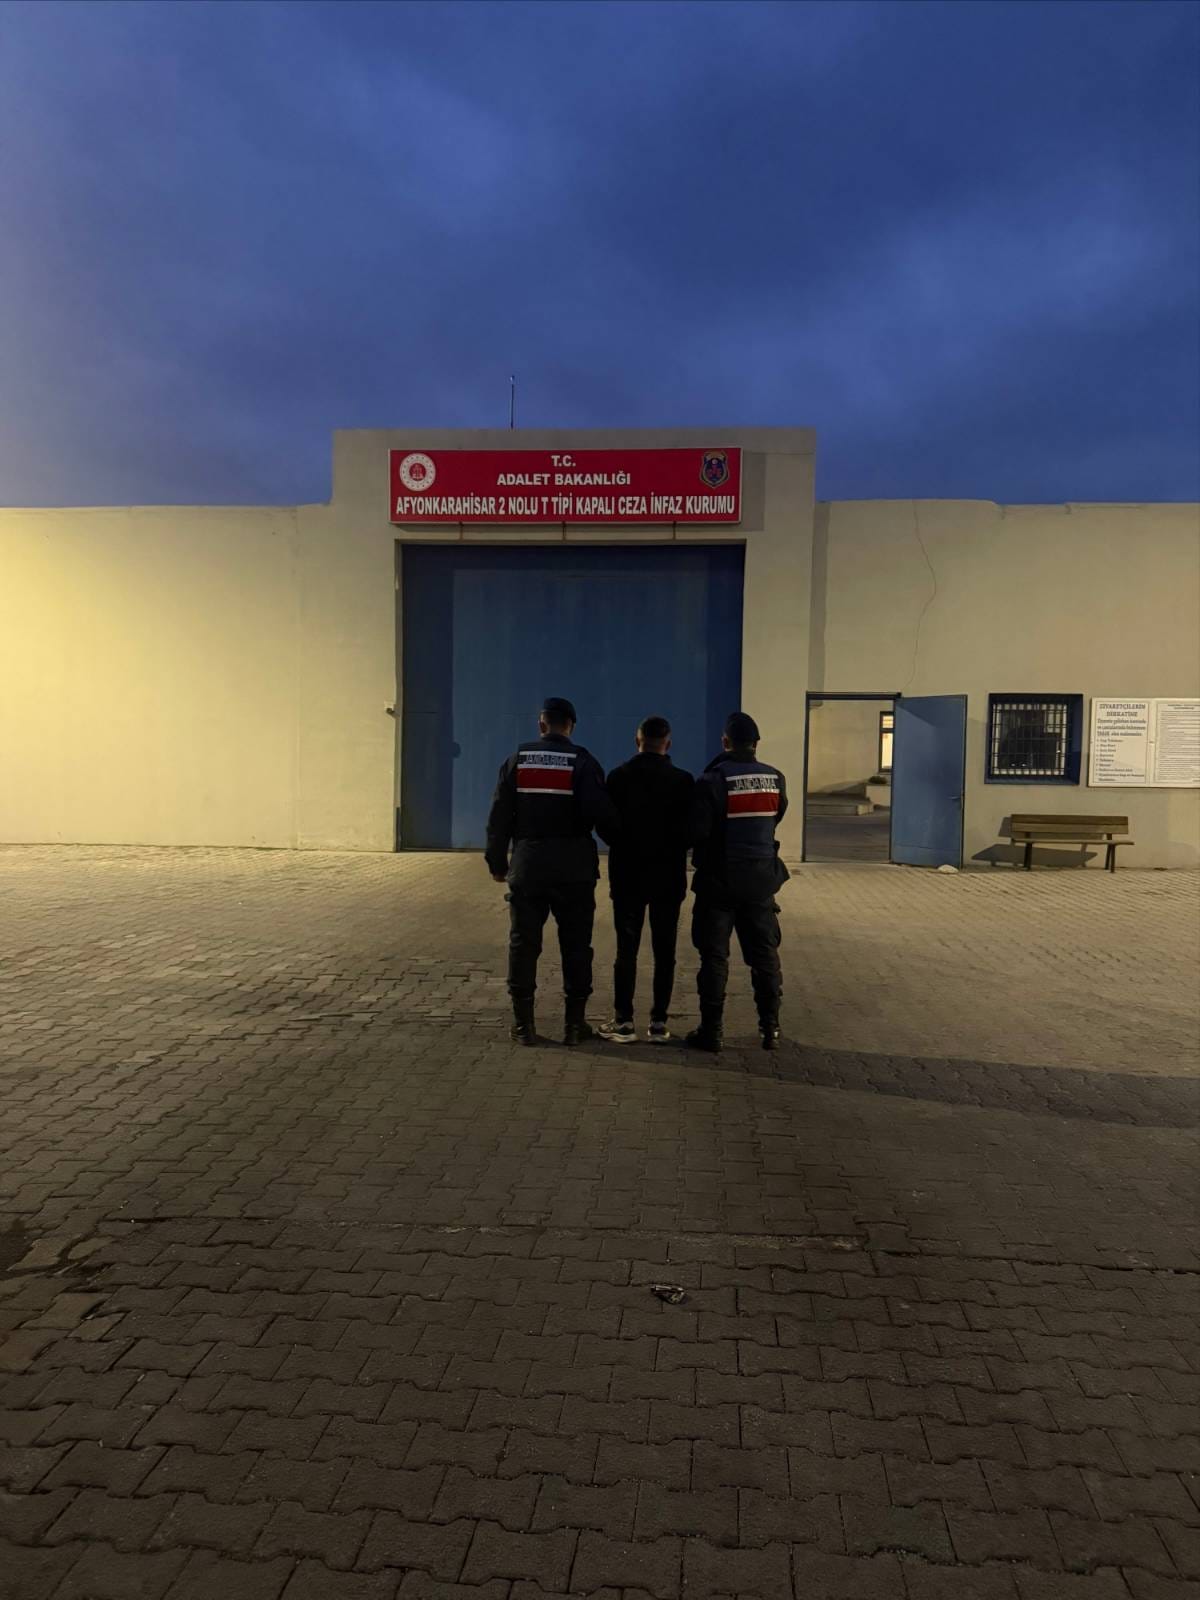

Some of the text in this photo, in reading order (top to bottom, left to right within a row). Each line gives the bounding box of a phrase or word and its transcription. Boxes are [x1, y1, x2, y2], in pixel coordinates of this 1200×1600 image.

[551, 455, 576, 467] T.C.
[497, 471, 631, 486] ADALET BAKANLIĞI
[396, 492, 735, 515] AFYONKARAHİSAR 2 NOLU T TİPİ KAPALI CEZA İNFAZ KURUMU
[733, 777, 777, 790] JANDARMA
